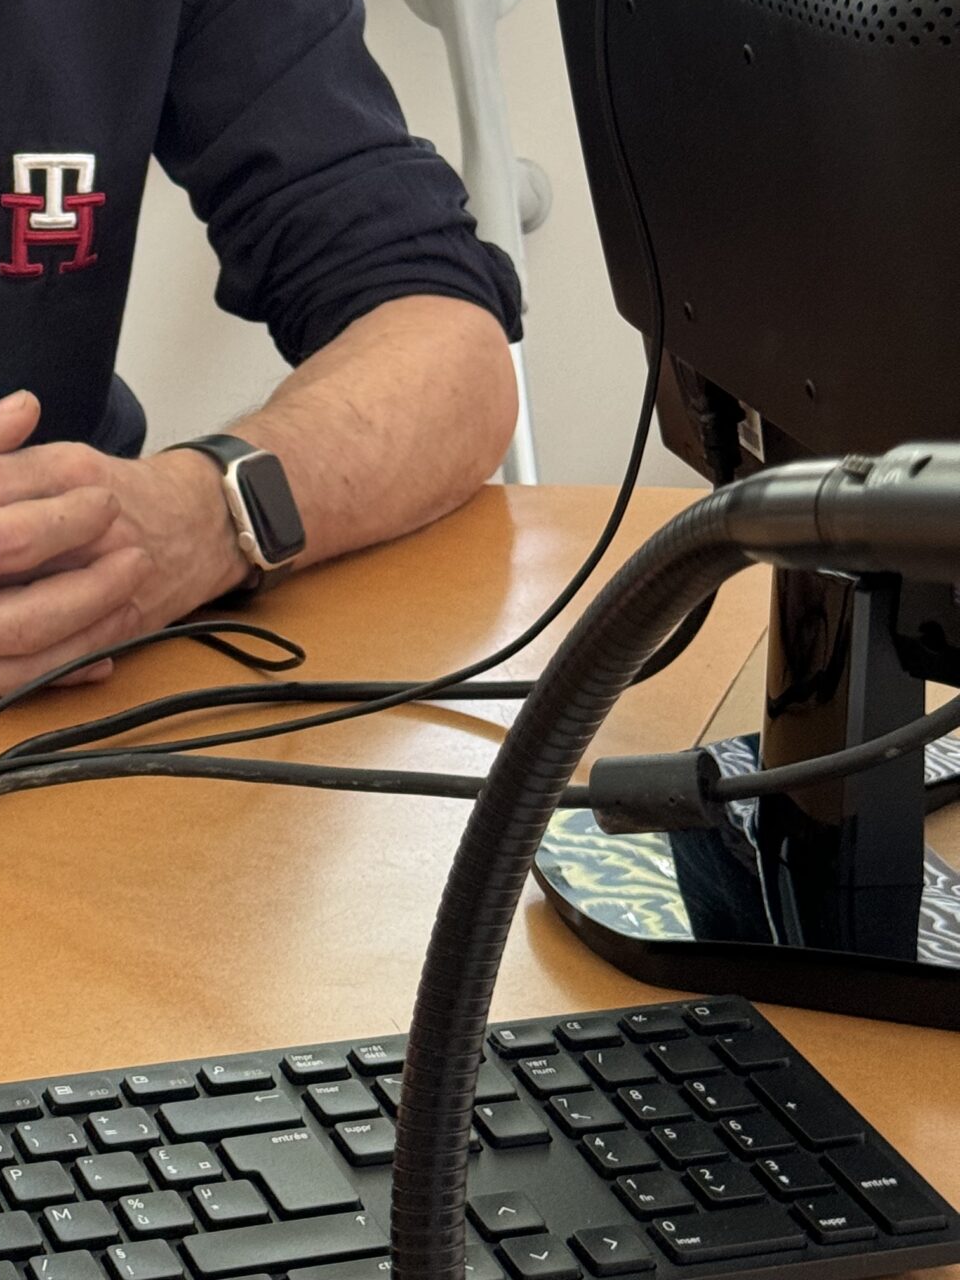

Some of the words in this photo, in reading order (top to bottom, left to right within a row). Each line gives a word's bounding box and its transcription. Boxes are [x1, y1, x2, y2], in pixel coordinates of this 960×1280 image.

[693, 1082, 705, 1092] 9
[629, 1090, 642, 1100] 8
[558, 1098, 567, 1108] 7
[344, 1124, 371, 1133] suppr
[729, 1120, 741, 1130] 6
[271, 1133, 308, 1143] entrée
[664, 1128, 677, 1139] 5
[595, 1137, 605, 1147] 4
[766, 1160, 779, 1170] 3
[10, 1169, 22, 1180] P
[700, 1169, 713, 1180] 2
[626, 1179, 637, 1189] 1
[128, 1198, 144, 1209] %
[51, 1208, 72, 1221] M
